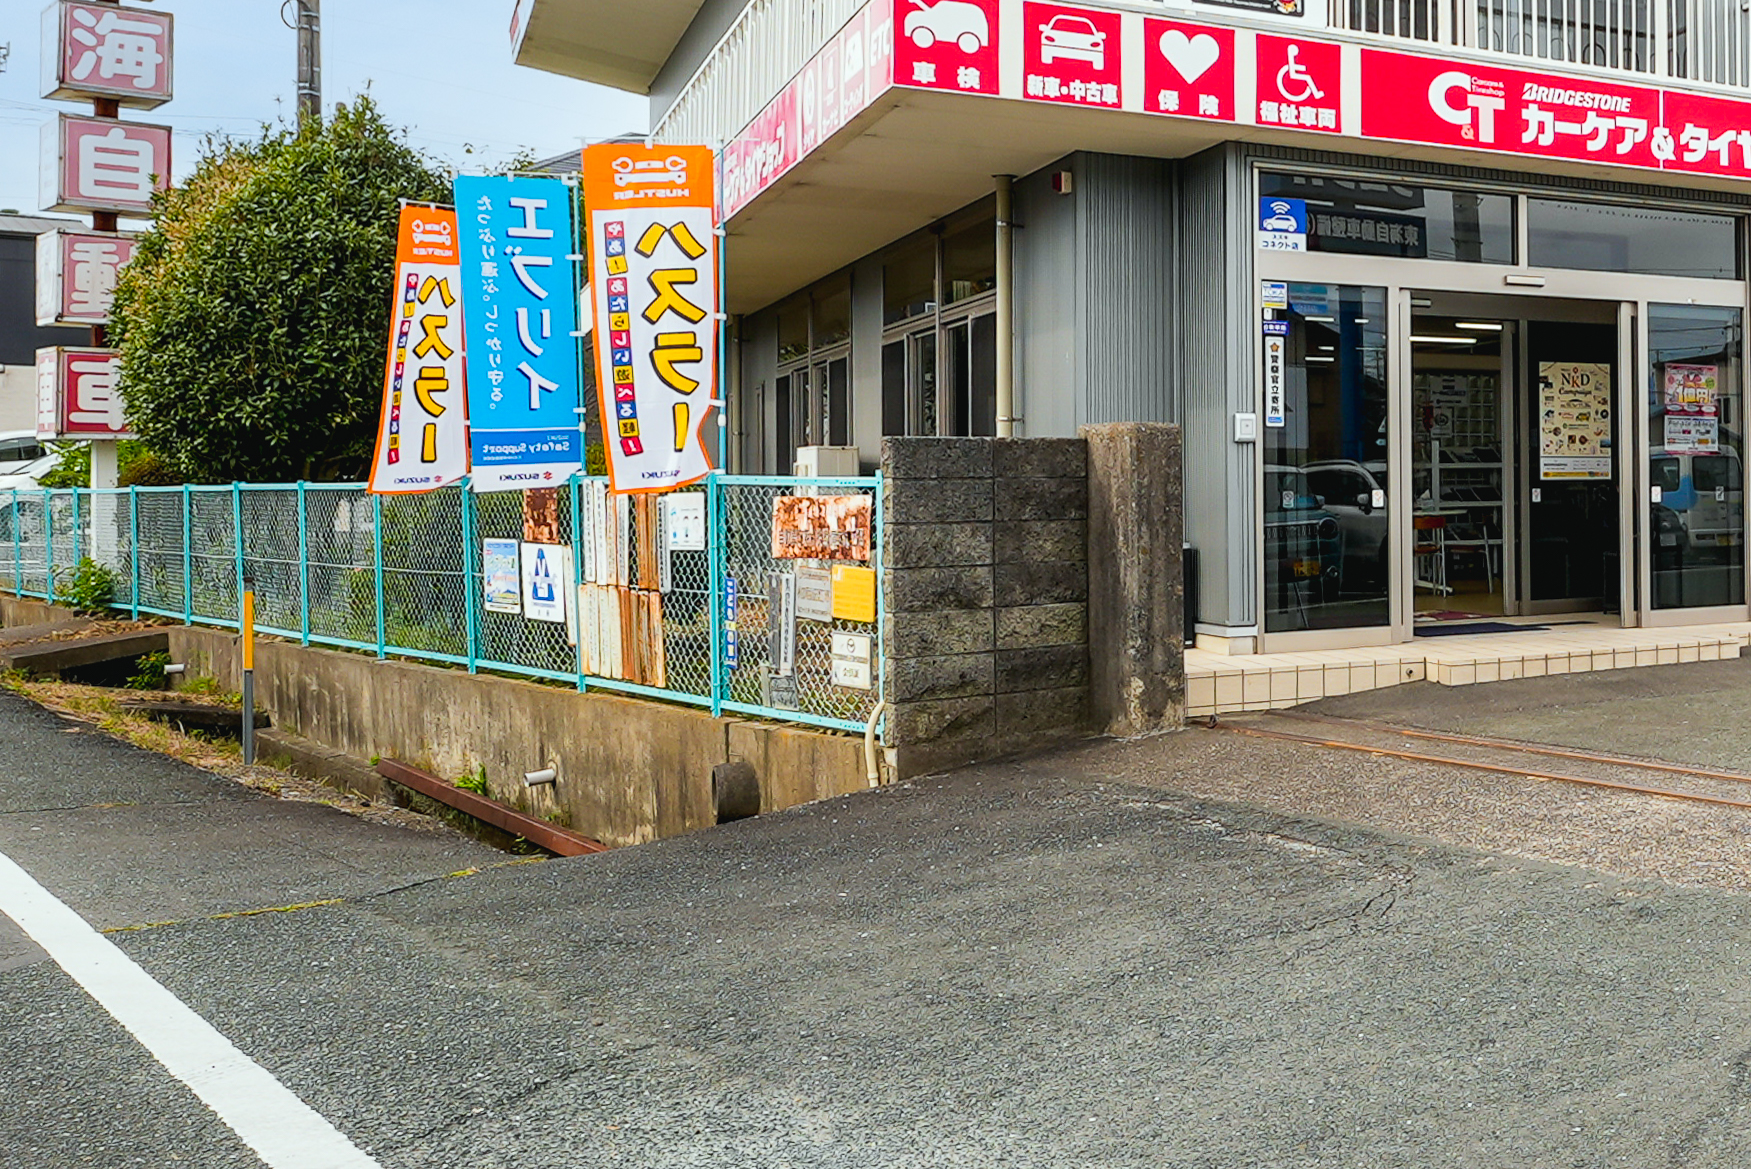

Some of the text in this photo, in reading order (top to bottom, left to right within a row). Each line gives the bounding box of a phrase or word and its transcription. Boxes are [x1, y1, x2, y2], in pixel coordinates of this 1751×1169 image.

[870, 18, 892, 68] ETC
[912, 61, 981, 90] 車検
[1027, 73, 1119, 105] 新車・中古車
[1158, 89, 1219, 116] 保険
[1522, 82, 1632, 113] BRIDGESTONE
[1260, 100, 1337, 129] 福祉車両
